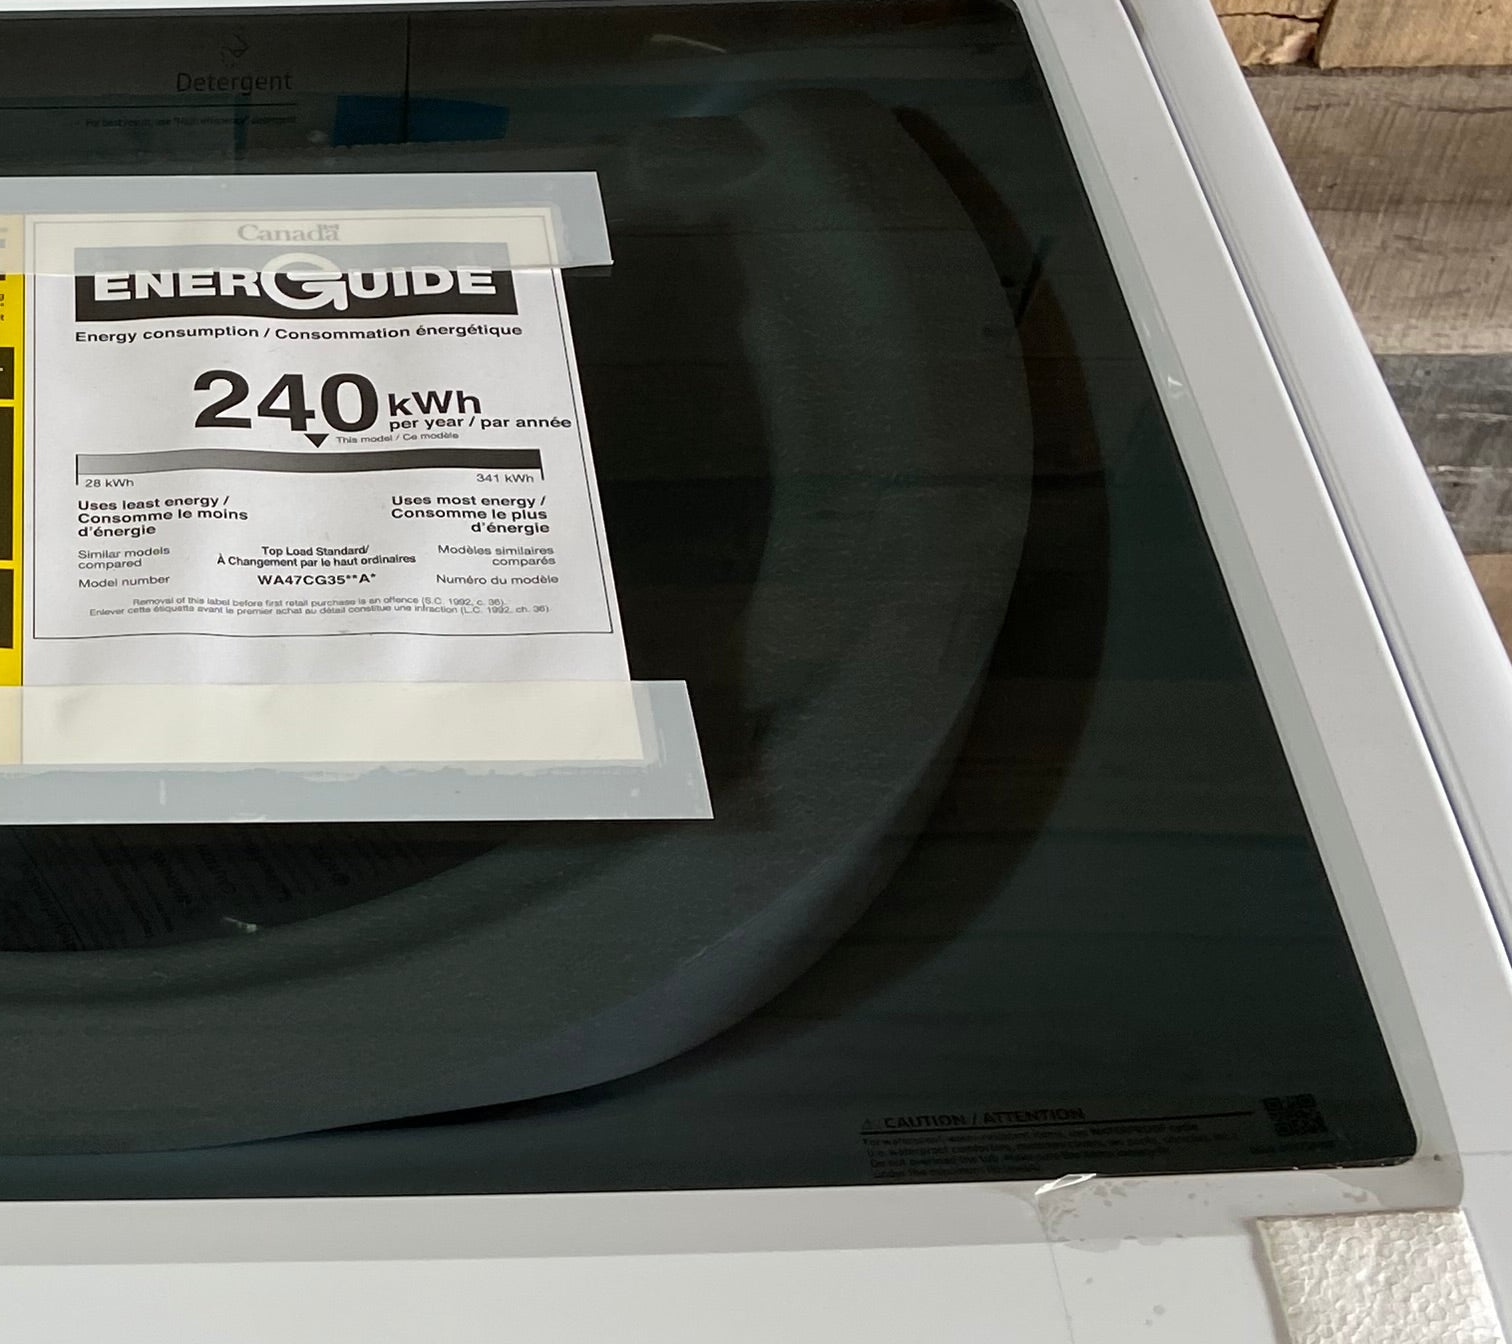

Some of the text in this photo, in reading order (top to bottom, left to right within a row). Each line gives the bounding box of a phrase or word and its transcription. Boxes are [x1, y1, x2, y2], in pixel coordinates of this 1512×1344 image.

[176, 70, 292, 95] Detergent
[238, 224, 340, 242] Canada
[94, 252, 496, 311] ENERGUIDE
[76, 331, 137, 344] Energy
[142, 326, 256, 341] consumption
[275, 326, 410, 341] Consommation
[416, 322, 522, 339] énergétique
[193, 370, 481, 433] 240 kWh
[390, 419, 418, 432] per
[425, 417, 464, 430] year
[481, 418, 510, 429] par
[516, 416, 572, 428] année
[85, 478, 134, 487] 28 kWh
[477, 473, 533, 483] 341 kWh
[78, 501, 117, 510] Uses
[123, 498, 160, 509] least
[165, 497, 218, 508] energy
[392, 496, 431, 505] Uses
[437, 496, 476, 505] most
[481, 497, 536, 508] energy
[78, 509, 248, 523] Consomme le moins
[391, 509, 547, 522] Consomme le plus
[78, 526, 156, 538] d'énergie
[471, 522, 549, 535] d'énergie
[262, 546, 369, 557] Top Load Standard/
[79, 575, 170, 588] Model number
[437, 575, 559, 584] Numéro du modèle
[884, 1114, 968, 1128] CAUTION
[983, 1107, 1084, 1124] ATTENTION
